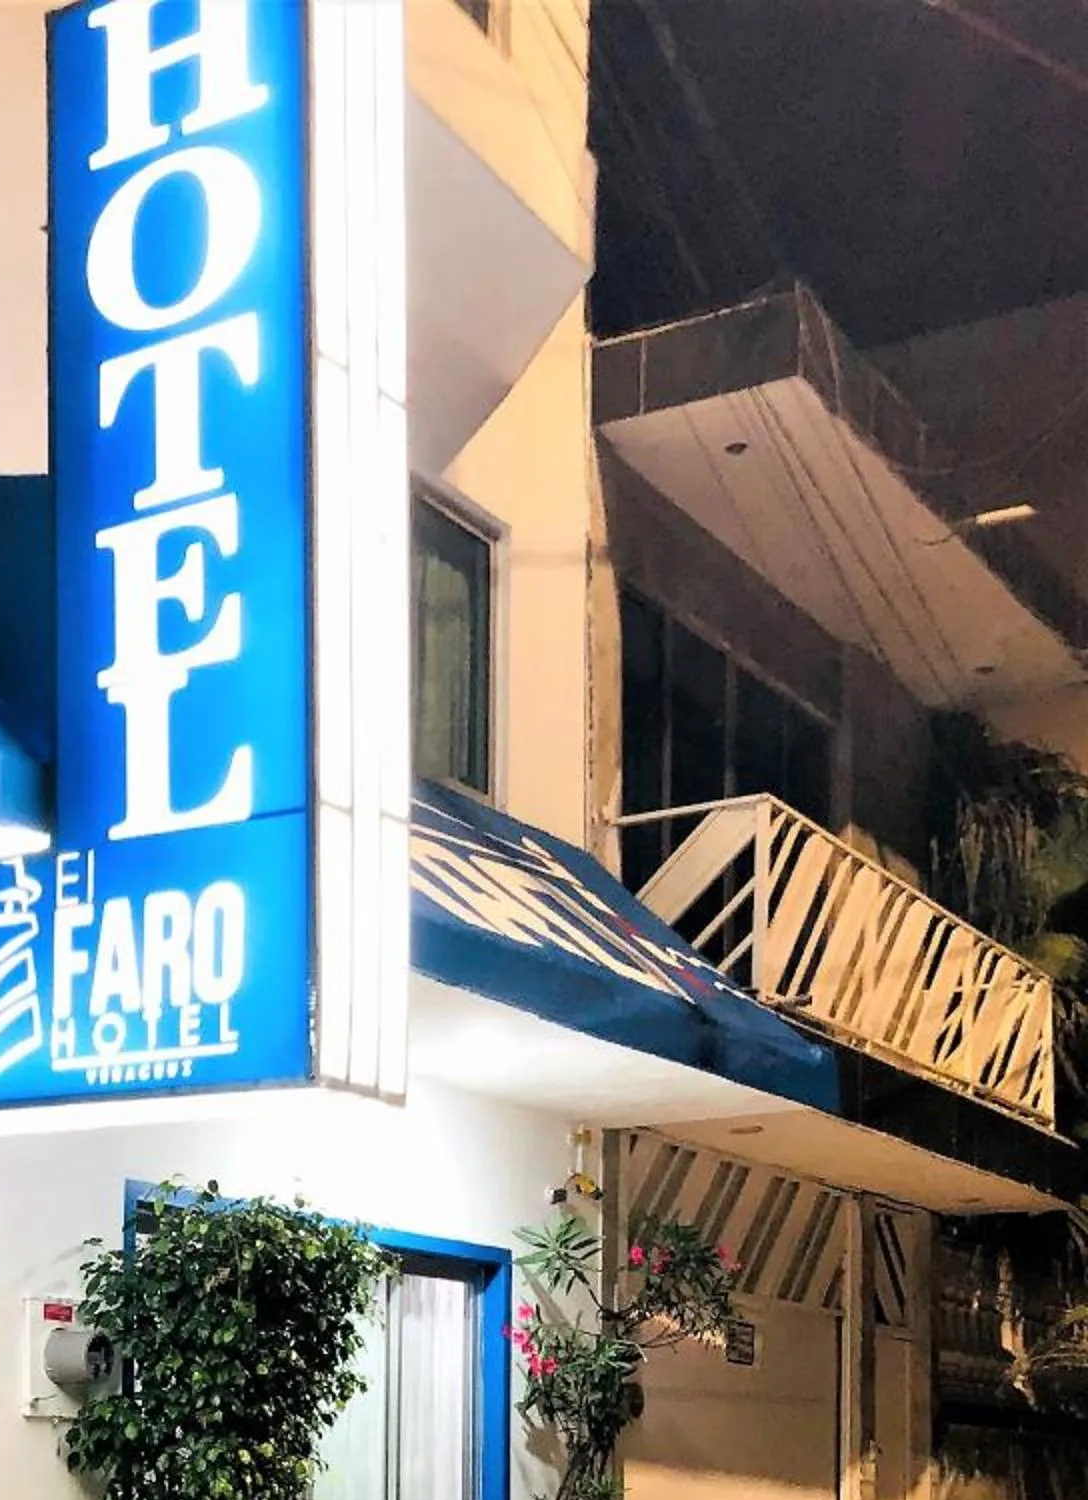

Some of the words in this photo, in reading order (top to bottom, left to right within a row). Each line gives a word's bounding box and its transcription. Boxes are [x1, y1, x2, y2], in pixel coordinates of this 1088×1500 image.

[86, 0, 269, 840] HOTEL
[52, 880, 246, 1019] FARO
[50, 1000, 240, 1061] HOTEL
